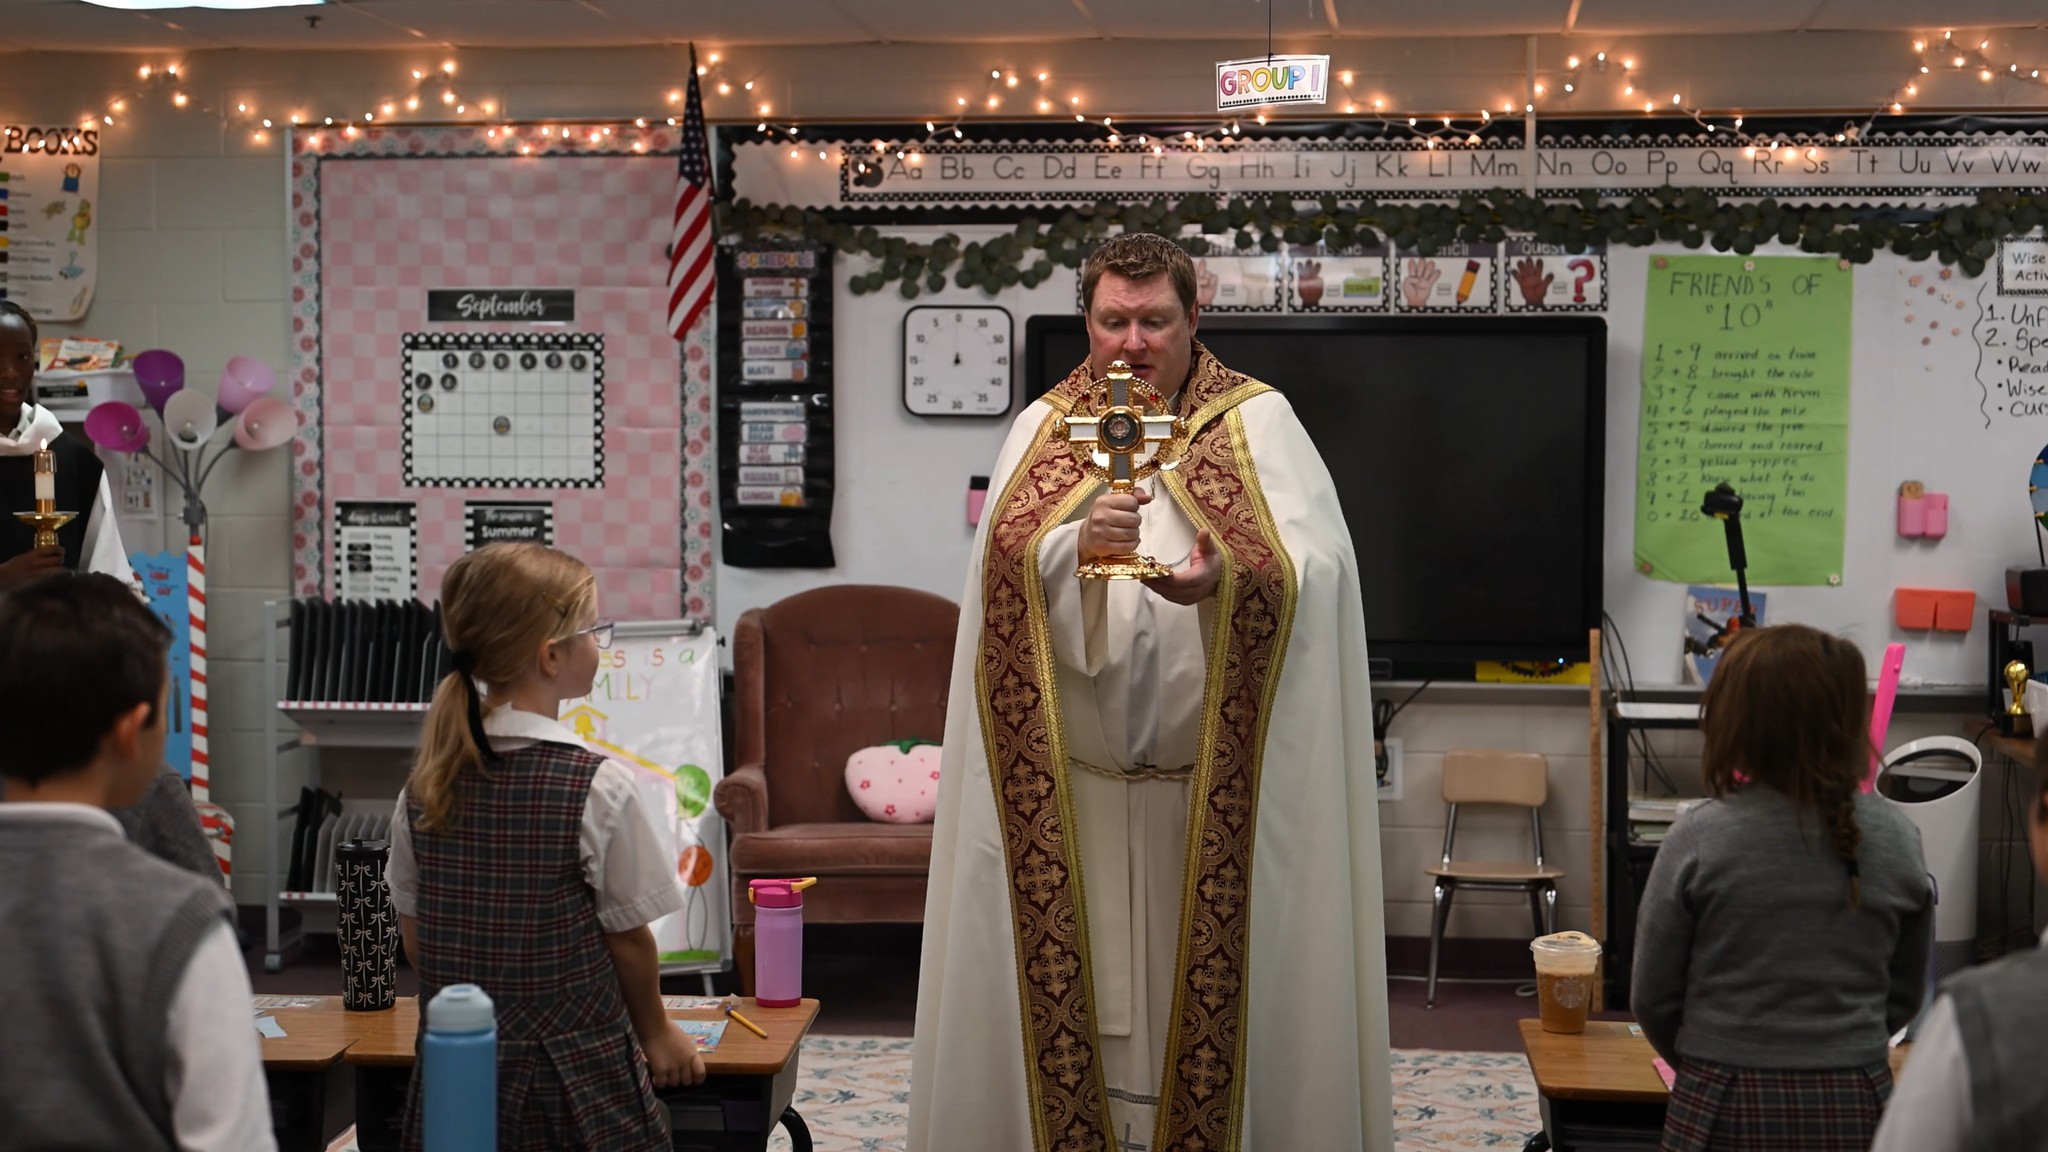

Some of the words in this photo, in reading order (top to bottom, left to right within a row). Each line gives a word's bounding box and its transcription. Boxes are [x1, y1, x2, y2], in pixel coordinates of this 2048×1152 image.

[1221, 65, 1306, 96] GROUP
[5, 126, 99, 157] BOOKS
[887, 157, 923, 180] Aa
[941, 156, 975, 180] Bb
[993, 156, 1025, 180] Cc
[1044, 156, 1077, 180] Dd
[1095, 155, 1122, 180] Ee
[1141, 155, 1168, 179] Ff
[1187, 156, 1221, 189] Gg
[1241, 155, 1274, 179] Hh
[1294, 155, 1310, 179] Ii
[1331, 154, 1356, 188] Jj
[1376, 154, 1408, 178] Kk
[1471, 153, 1518, 177] Mm
[1537, 152, 1573, 175] Nn
[1592, 151, 1627, 175] Oo
[1648, 150, 1678, 186] Pp
[1699, 150, 1738, 185] Qq
[1753, 150, 1783, 174] Rr
[1804, 149, 1829, 174] Ss
[1850, 149, 1879, 174] Tt
[1900, 149, 1931, 174] Uu
[1945, 149, 1974, 174] Vv
[1988, 149, 2041, 174] Ww
[738, 251, 814, 269] SCHEDULE
[2013, 252, 2046, 265] Wise
[1670, 273, 1772, 297] FRIENDS
[1793, 274, 1824, 296] OF
[456, 291, 545, 319] September
[1985, 304, 2005, 322] 1.
[955, 313, 962, 323] 0
[978, 318, 988, 328] 55
[993, 335, 1004, 344] 50
[1985, 327, 2007, 347] 2.
[1655, 343, 1664, 362] 1
[1690, 343, 1702, 361] 9
[1687, 363, 1698, 379] 8
[990, 377, 1002, 386] 40
[1750, 440, 1773, 450] and
[481, 525, 537, 538] Summer
